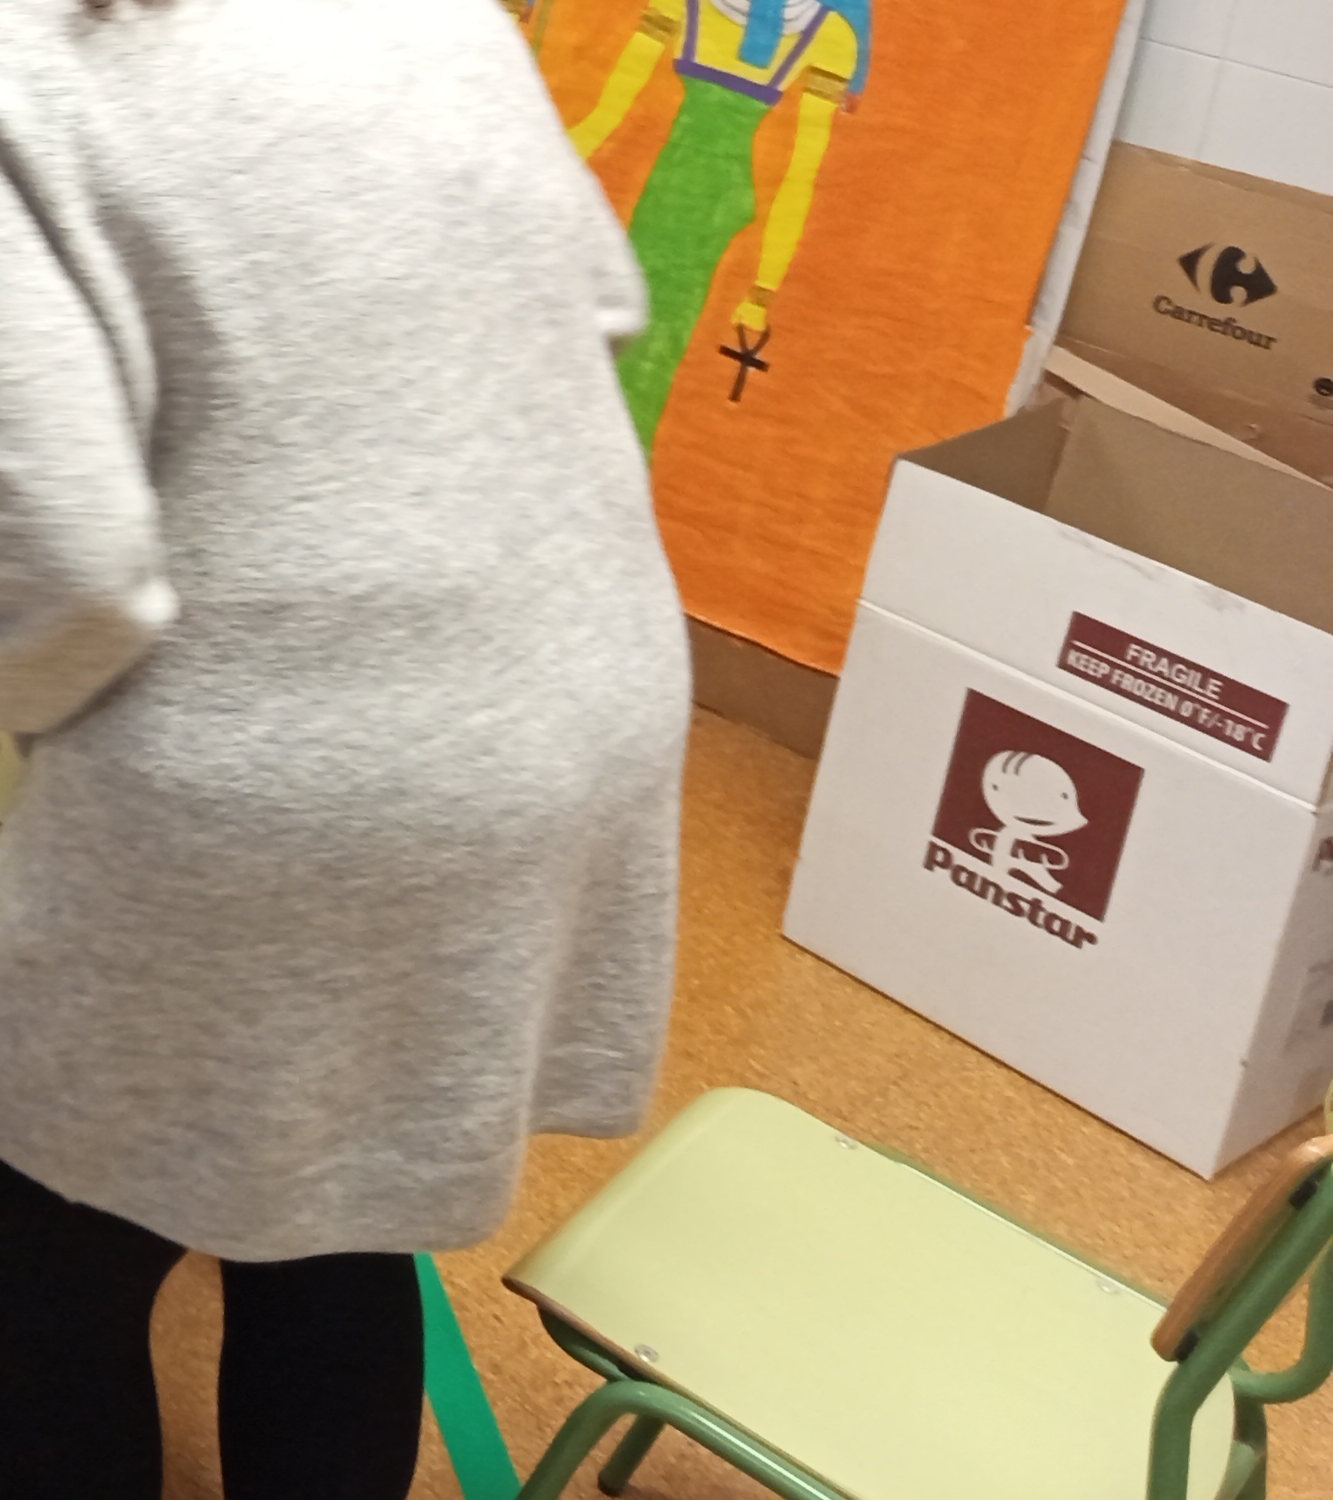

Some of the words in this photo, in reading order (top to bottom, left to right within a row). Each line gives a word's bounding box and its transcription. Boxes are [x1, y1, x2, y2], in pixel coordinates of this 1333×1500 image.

[1152, 294, 1278, 350] Carrefour
[1066, 649, 1111, 679] KEEP
[1110, 668, 1180, 712] FROZEN
[1125, 642, 1224, 700] FRAGILE
[923, 840, 1098, 949] Panstar
